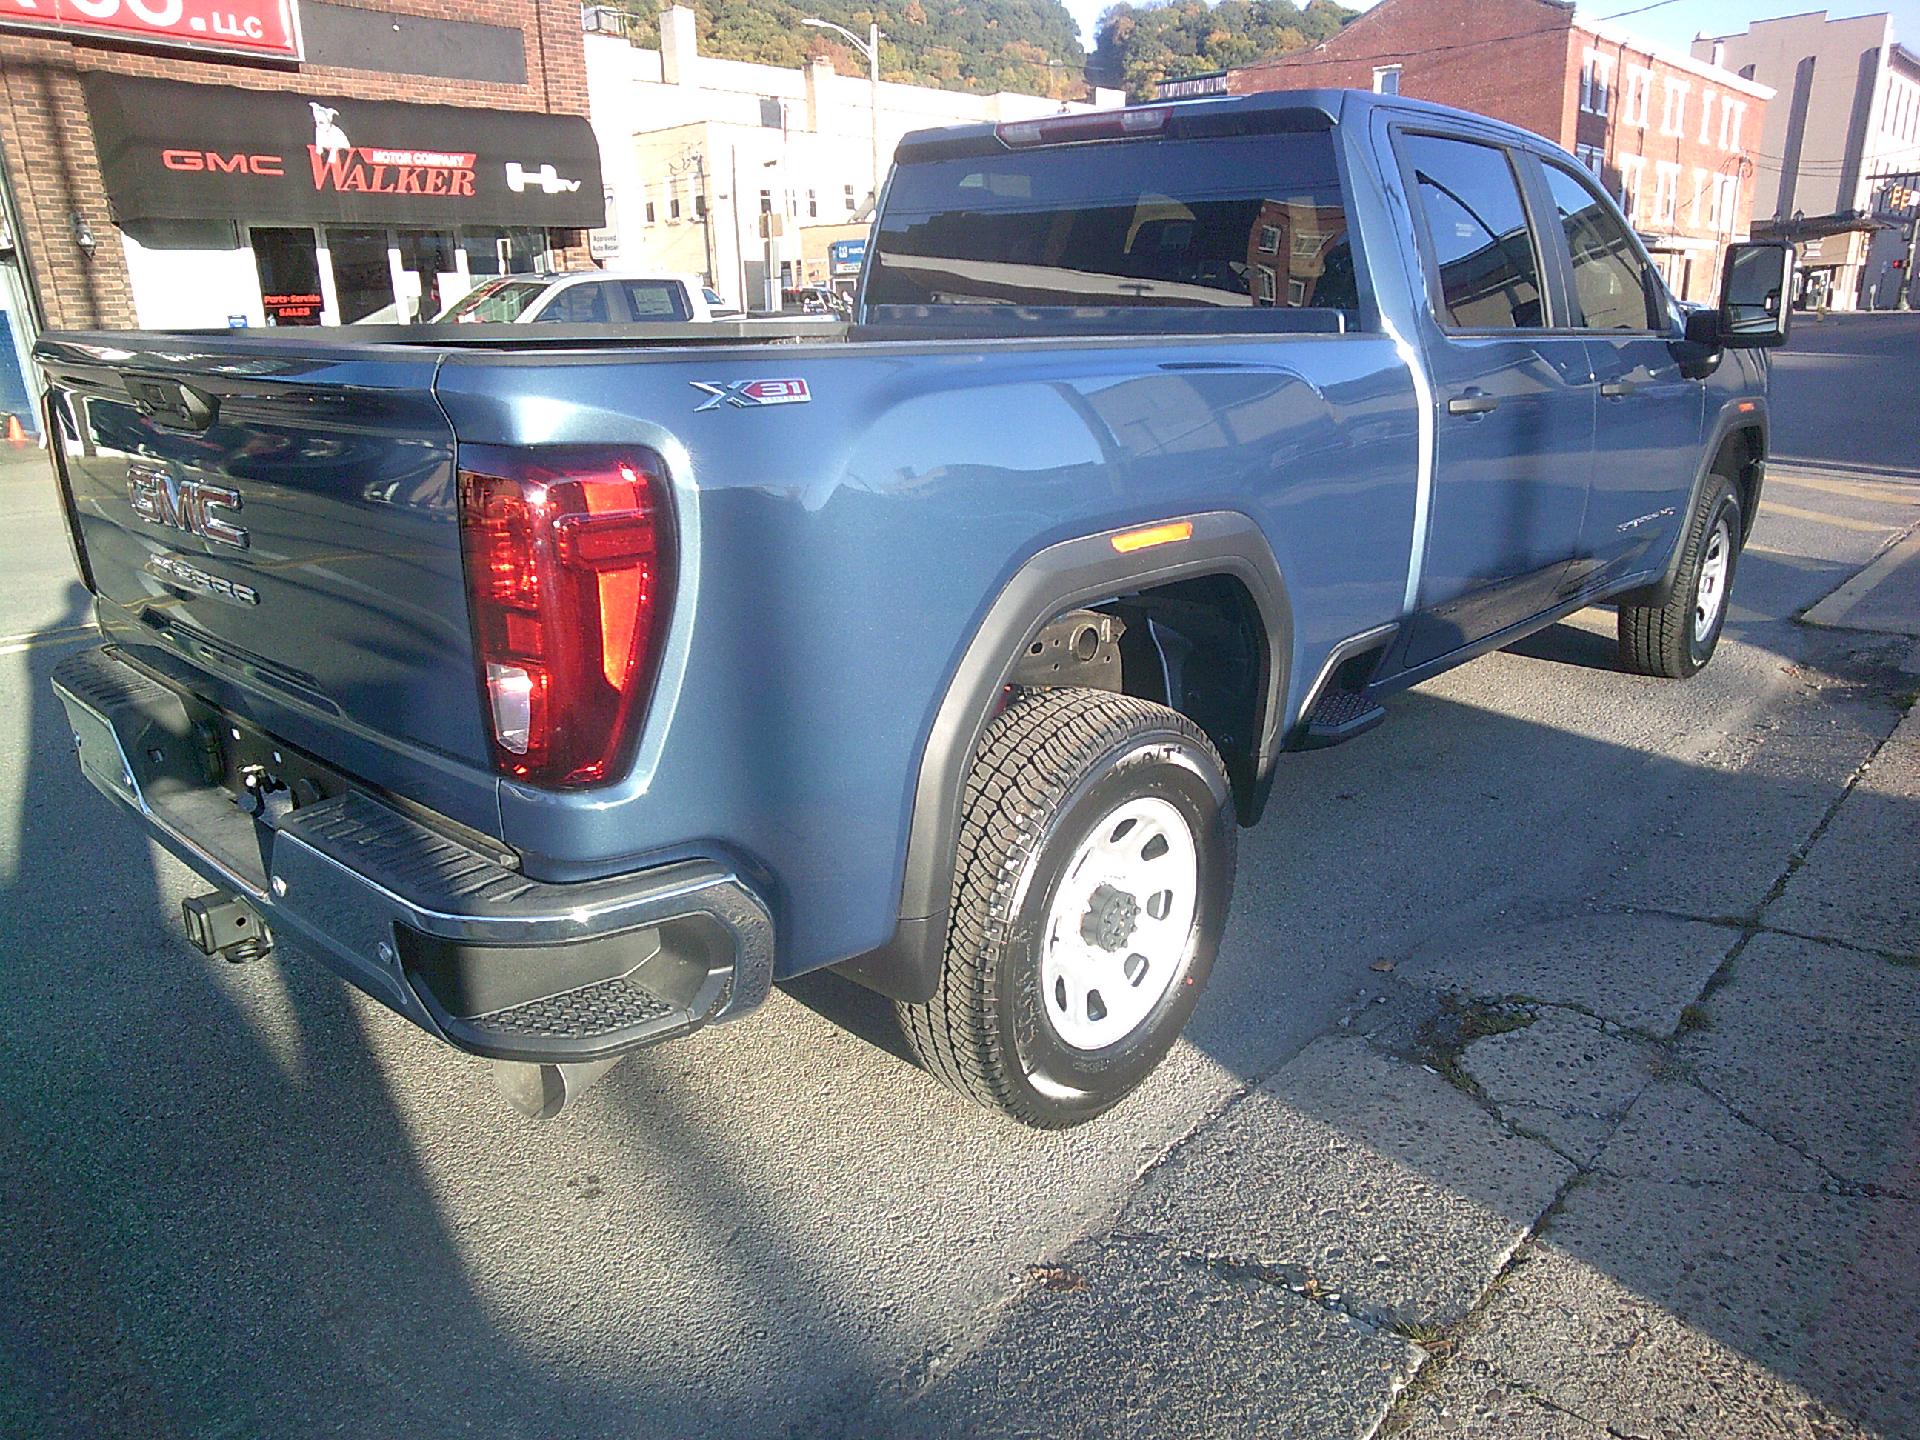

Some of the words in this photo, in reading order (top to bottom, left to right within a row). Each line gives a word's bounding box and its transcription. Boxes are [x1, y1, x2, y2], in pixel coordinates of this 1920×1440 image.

[213, 11, 263, 39] LLC
[162, 149, 285, 176] GMC
[307, 144, 476, 196] WALKER
[372, 150, 412, 164] MOTOR
[413, 153, 465, 167] COMPANY
[278, 307, 311, 317] SALES
[126, 464, 251, 549] GMC
